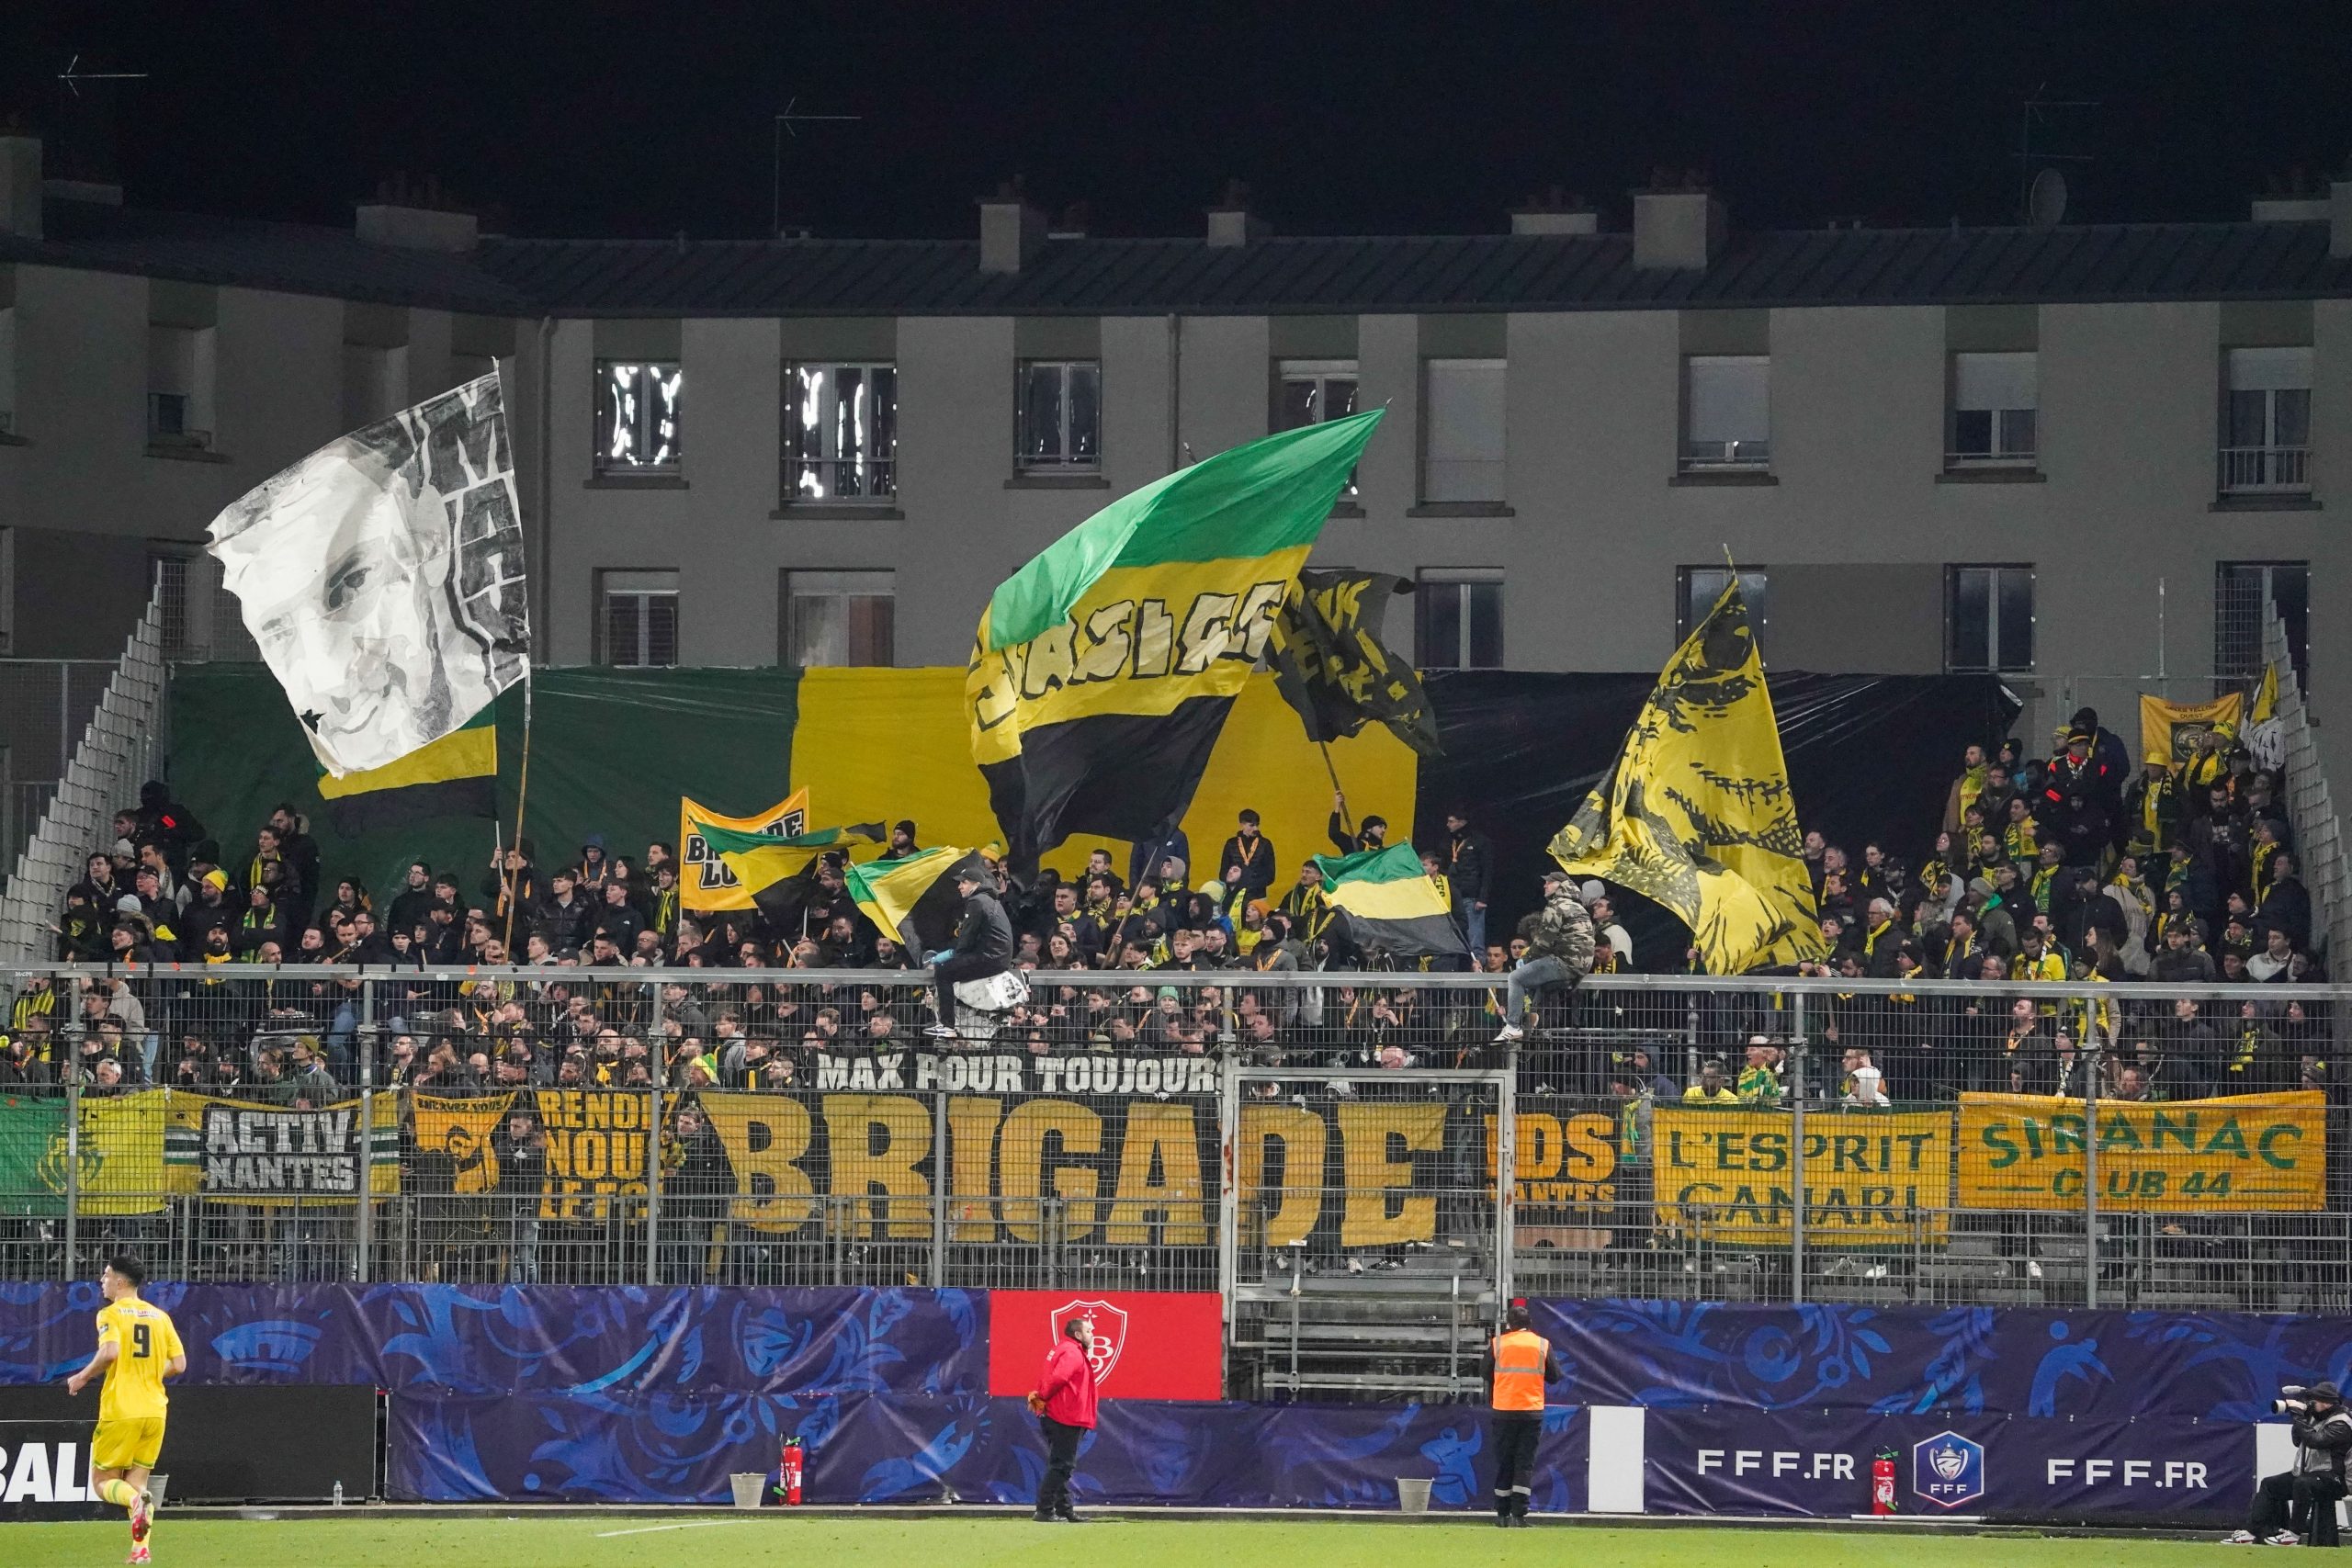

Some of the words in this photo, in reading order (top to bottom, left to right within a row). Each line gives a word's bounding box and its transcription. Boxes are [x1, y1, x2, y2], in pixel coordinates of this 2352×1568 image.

[817, 1054, 903, 1090] MAX
[916, 1053, 1023, 1092] POUR
[1035, 1056, 1223, 1093] TOUJOUR
[205, 1108, 353, 1155] ACTIV
[1670, 1130, 1935, 1173] L'ESPRIT
[1982, 1110, 2304, 1171] SIRANAC
[206, 1154, 355, 1191] NANTES
[545, 1129, 668, 1180] NOU
[699, 1091, 1448, 1248] BRIGADE
[1677, 1181, 1918, 1224] CANARI
[2180, 1172, 2232, 1198] 44
[132, 1323, 151, 1359] 9
[1698, 1449, 1856, 1482] FFF.FR
[2047, 1459, 2209, 1491] FFF.FR
[1930, 1483, 1967, 1495] FFF
